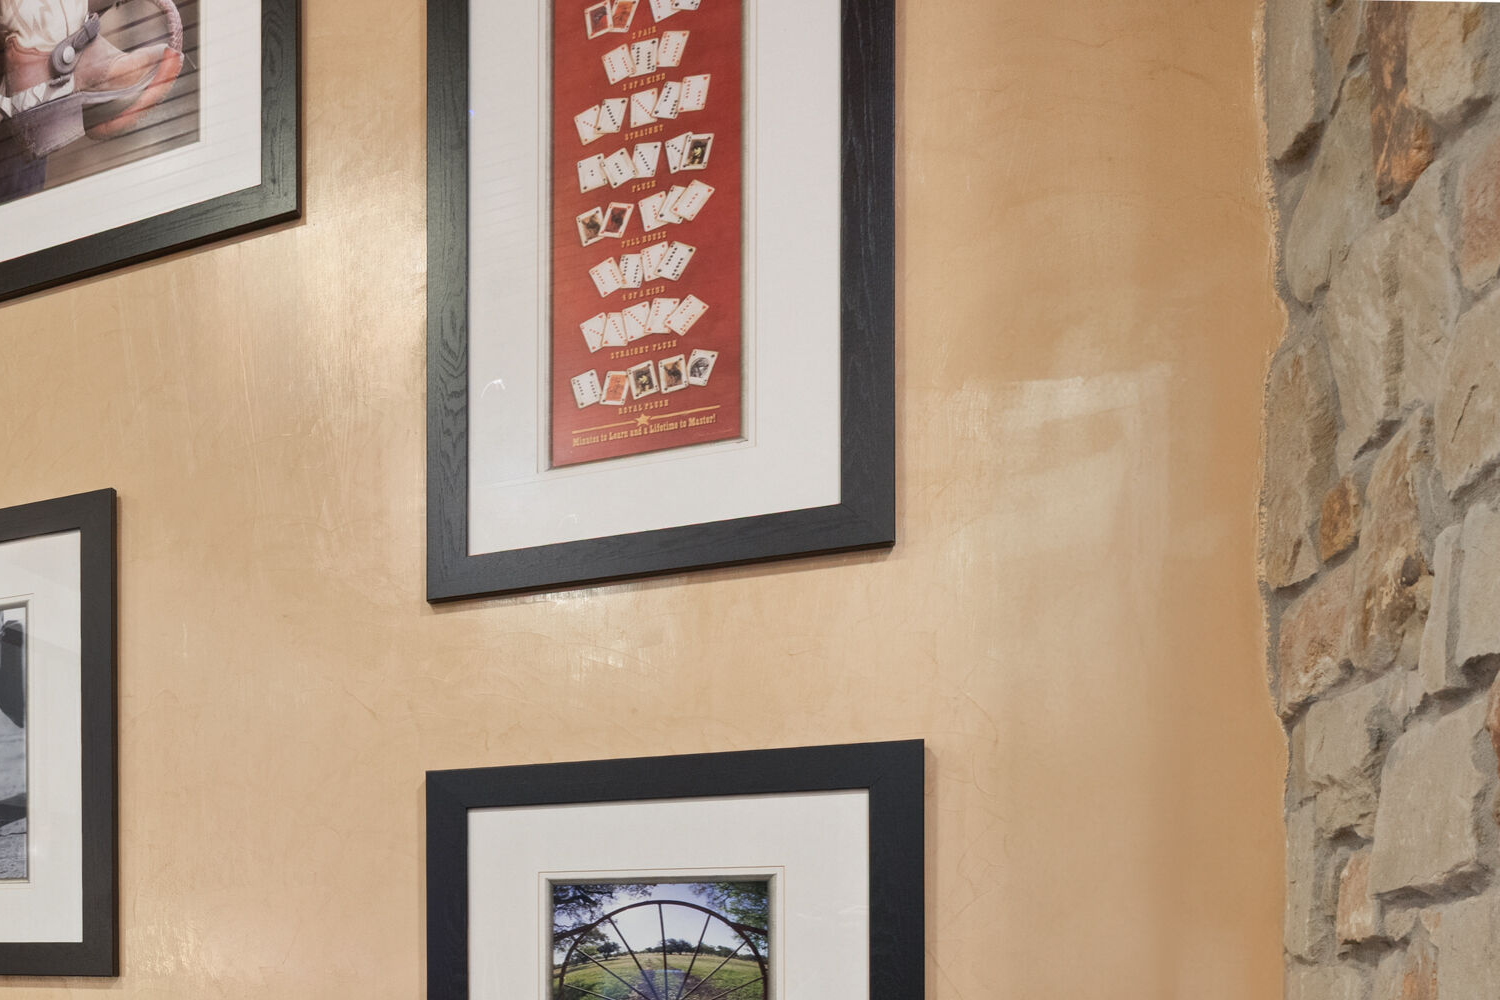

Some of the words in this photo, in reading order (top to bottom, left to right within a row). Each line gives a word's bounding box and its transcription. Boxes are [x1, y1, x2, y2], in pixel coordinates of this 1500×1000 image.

[637, 26, 657, 38] PAIR
[646, 73, 666, 84] KIND
[625, 124, 664, 141] STRAIGHT
[631, 180, 656, 192] FLUSH
[621, 237, 640, 248] FULL
[642, 231, 667, 243] HOUSE
[646, 285, 666, 295] KIND
[610, 345, 649, 360] STRAIGHT
[652, 340, 677, 351] FLUSH
[618, 404, 642, 415] ROYAL
[644, 399, 669, 409] FLUSH
[572, 436, 599, 447] Minutes
[609, 431, 628, 440] Learn
[630, 426, 642, 437] and
[649, 421, 678, 434] Lifetime
[680, 419, 687, 429] to
[688, 413, 716, 427] Master!
